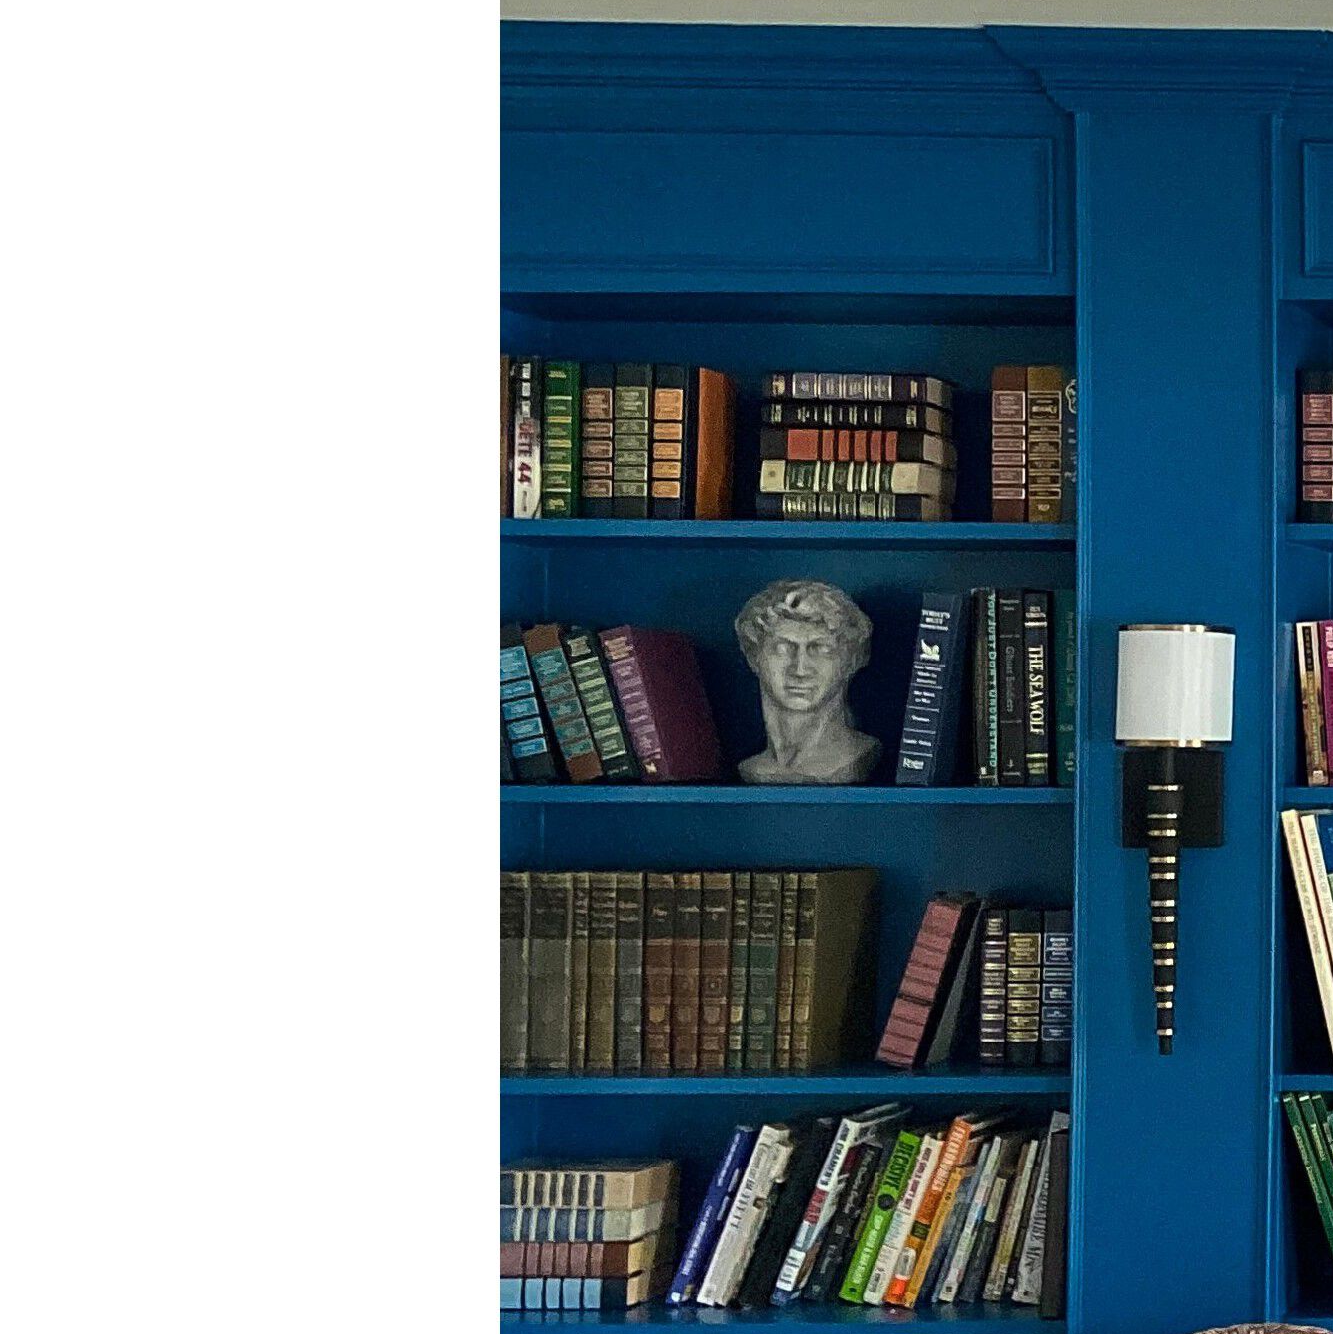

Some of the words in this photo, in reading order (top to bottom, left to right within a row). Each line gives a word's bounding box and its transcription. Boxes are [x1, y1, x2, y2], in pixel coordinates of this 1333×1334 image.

[1027, 644, 1043, 672] THE
[1028, 673, 1043, 698] SEA
[1029, 699, 1044, 735] WOLF
[881, 1139, 915, 1192] DECISIVE
